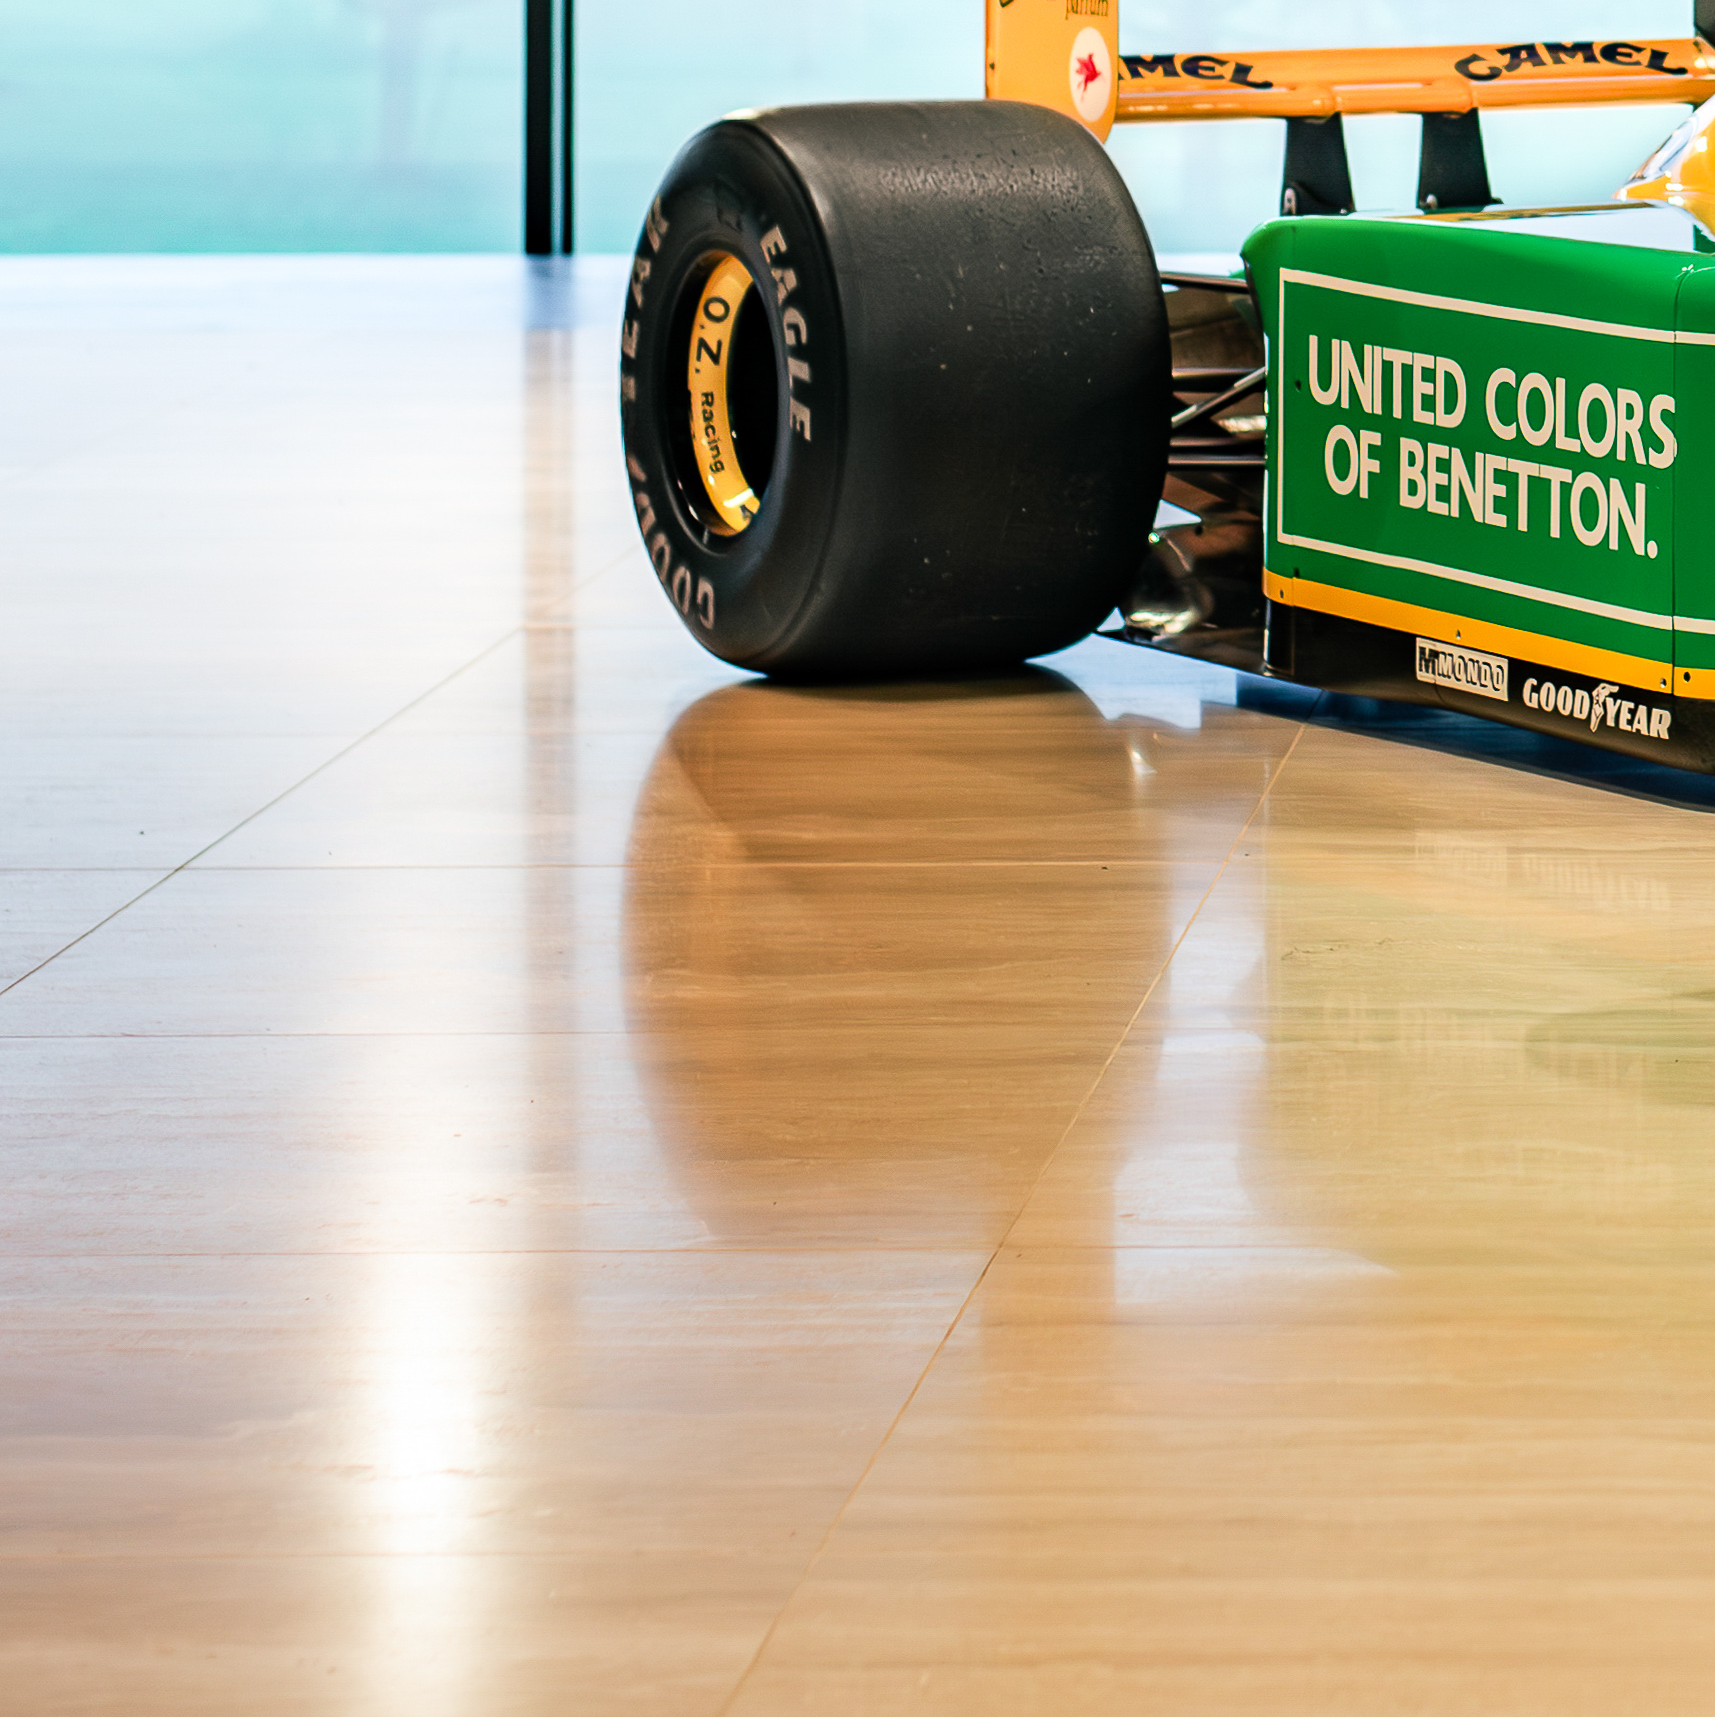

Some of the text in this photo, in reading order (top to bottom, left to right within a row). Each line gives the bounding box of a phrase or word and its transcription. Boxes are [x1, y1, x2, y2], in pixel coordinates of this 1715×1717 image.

[1118, 54, 1274, 89] MEL
[1454, 40, 1688, 81] CAMEL
[758, 223, 813, 442] EAGLE
[699, 390, 725, 476] Racing
[1309, 334, 1678, 469] UNITED COLORS
[1323, 423, 1659, 560] OF BENETTON.
[1522, 677, 1672, 740] GOODYEAR
